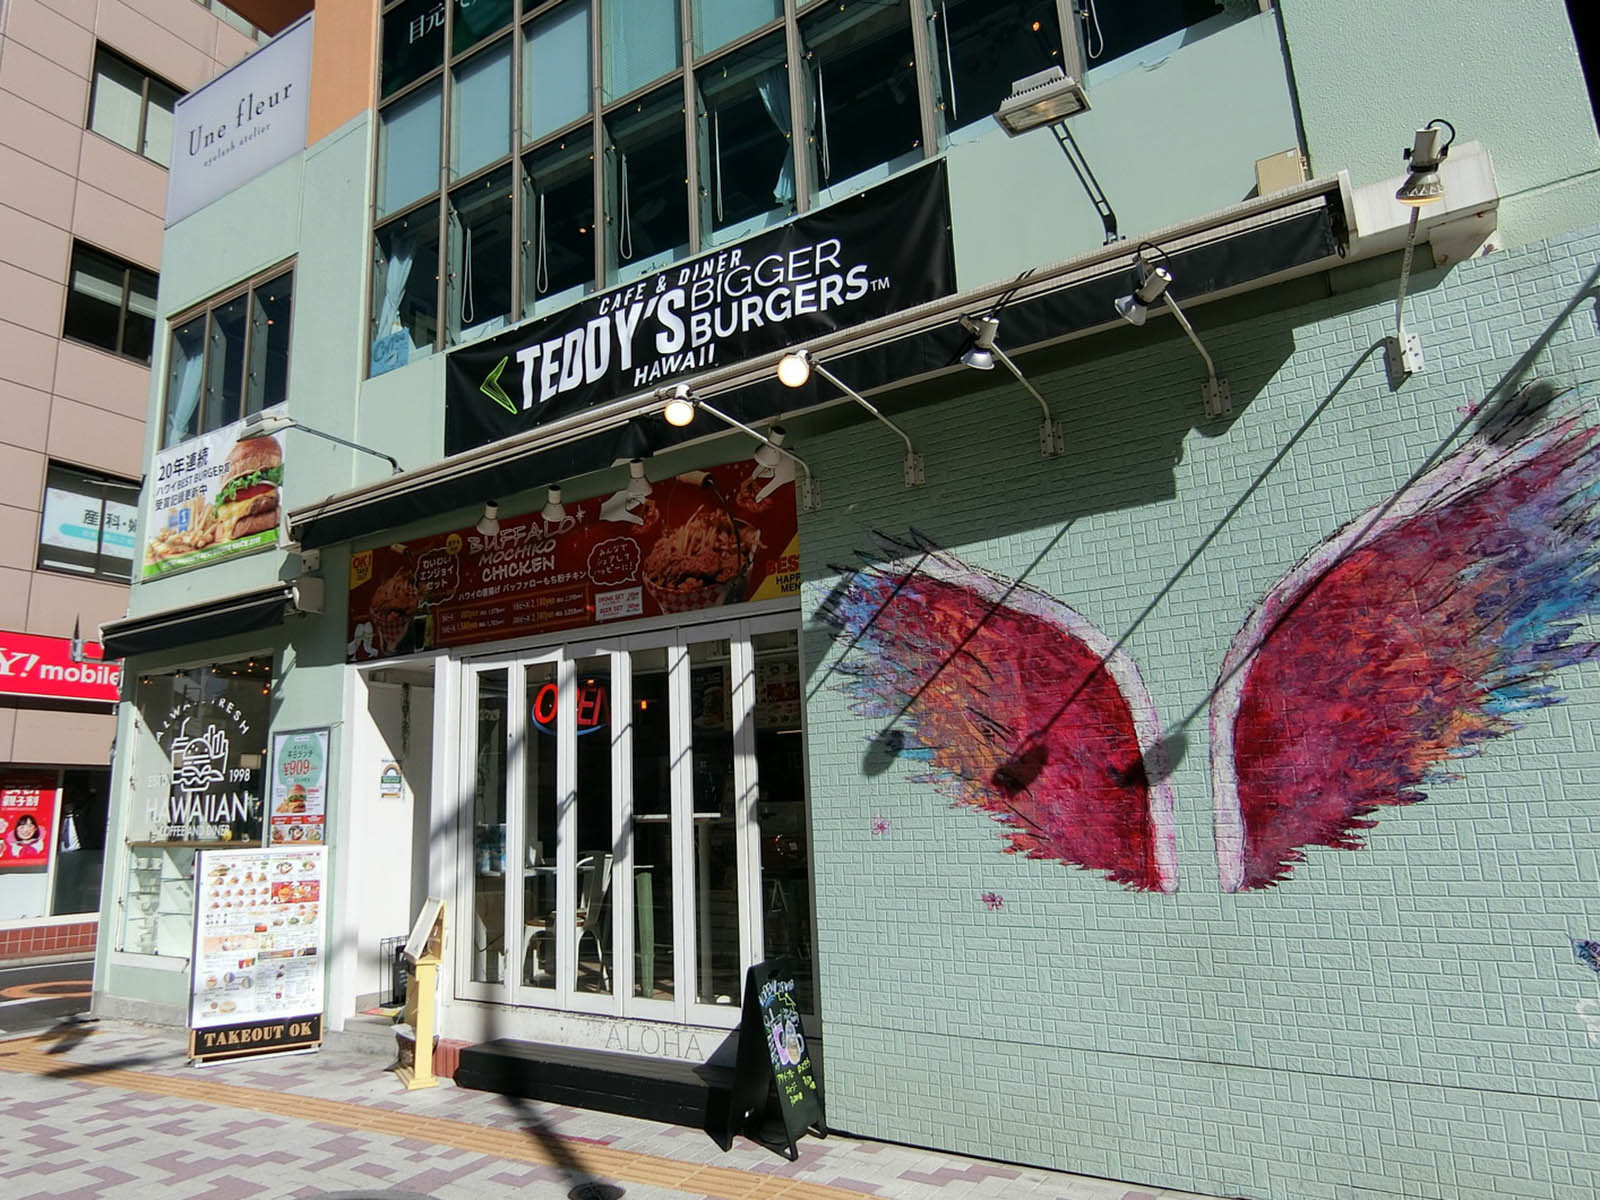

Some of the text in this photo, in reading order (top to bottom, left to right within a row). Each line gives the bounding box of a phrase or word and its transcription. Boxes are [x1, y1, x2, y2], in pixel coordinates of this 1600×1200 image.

[189, 83, 293, 157] Une fleur
[599, 247, 743, 315] CAFE & DINER
[691, 238, 841, 312] BIGGER
[691, 265, 869, 348] BURGERS
[516, 289, 685, 411] TEDDY'S
[633, 344, 715, 388] HAWAII
[158, 447, 209, 482] 20年連続
[467, 515, 577, 555] BUFFALO
[478, 539, 556, 567] MOCHIKO
[481, 555, 555, 582] CHICKEN
[40, 663, 120, 686] mobile
[229, 768, 250, 783] 1998
[147, 790, 249, 824] HAWAIIAN
[203, 1021, 312, 1048] TAKEOUT OK
[604, 1023, 705, 1062] ALOHA
